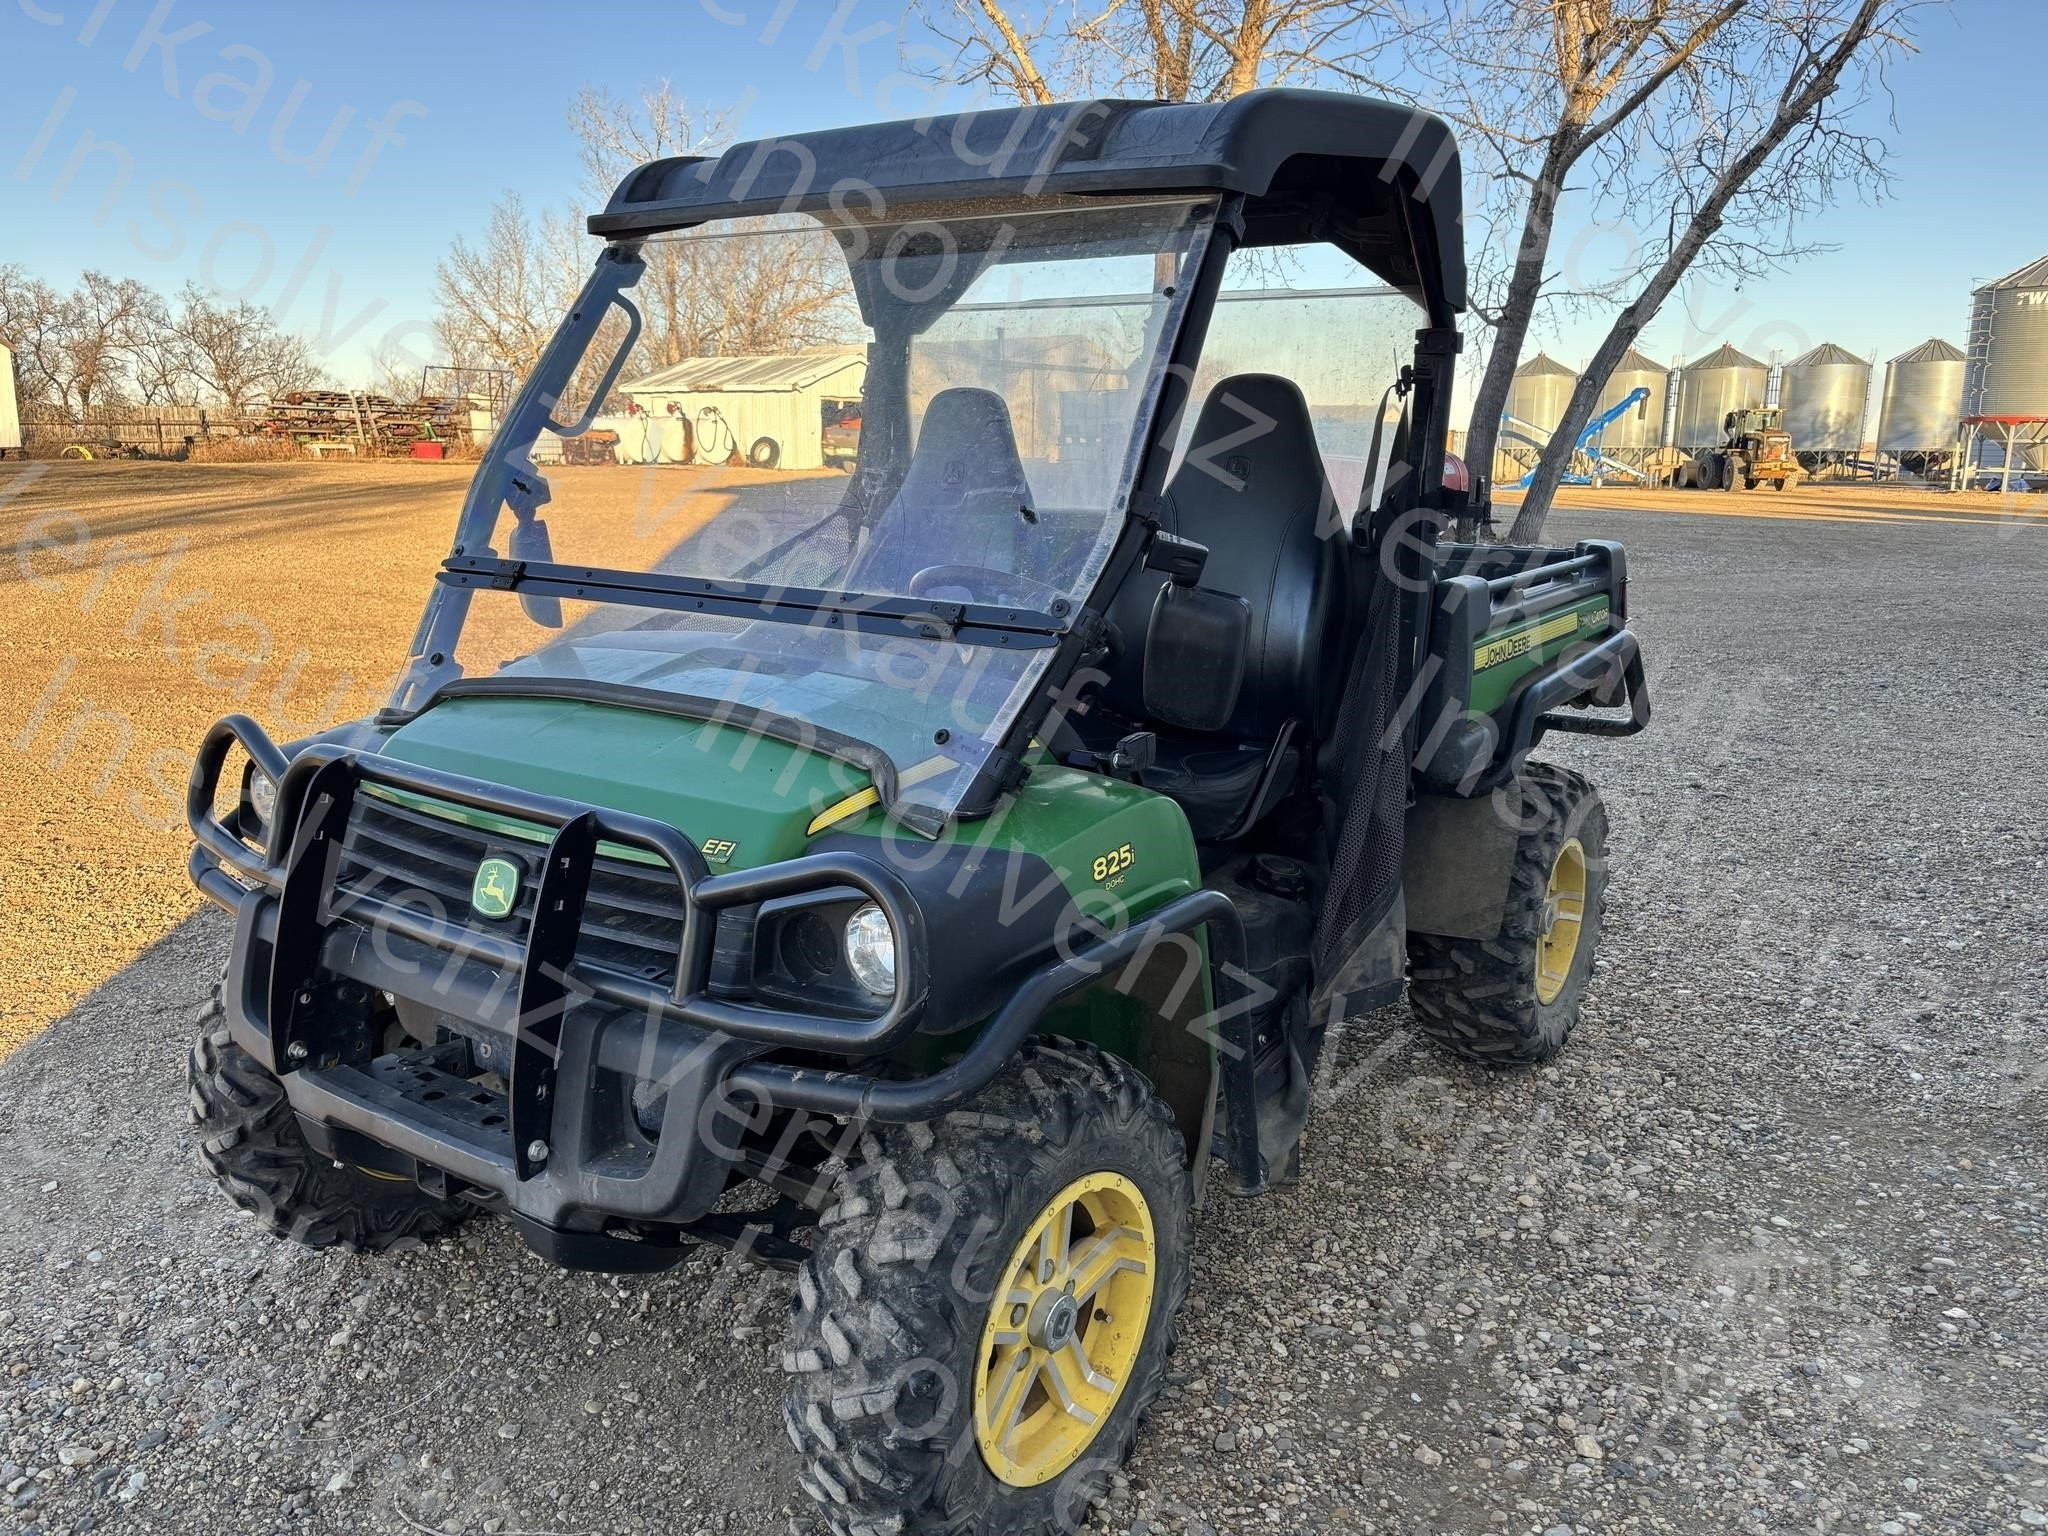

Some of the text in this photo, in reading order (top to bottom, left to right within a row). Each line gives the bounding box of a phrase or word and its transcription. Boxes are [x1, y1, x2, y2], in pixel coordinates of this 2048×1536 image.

[2016, 290, 2048, 306] TW
[1484, 634, 1531, 667] JOHN DEERE
[701, 839, 737, 857] EFI
[1093, 843, 1135, 881] 825i
